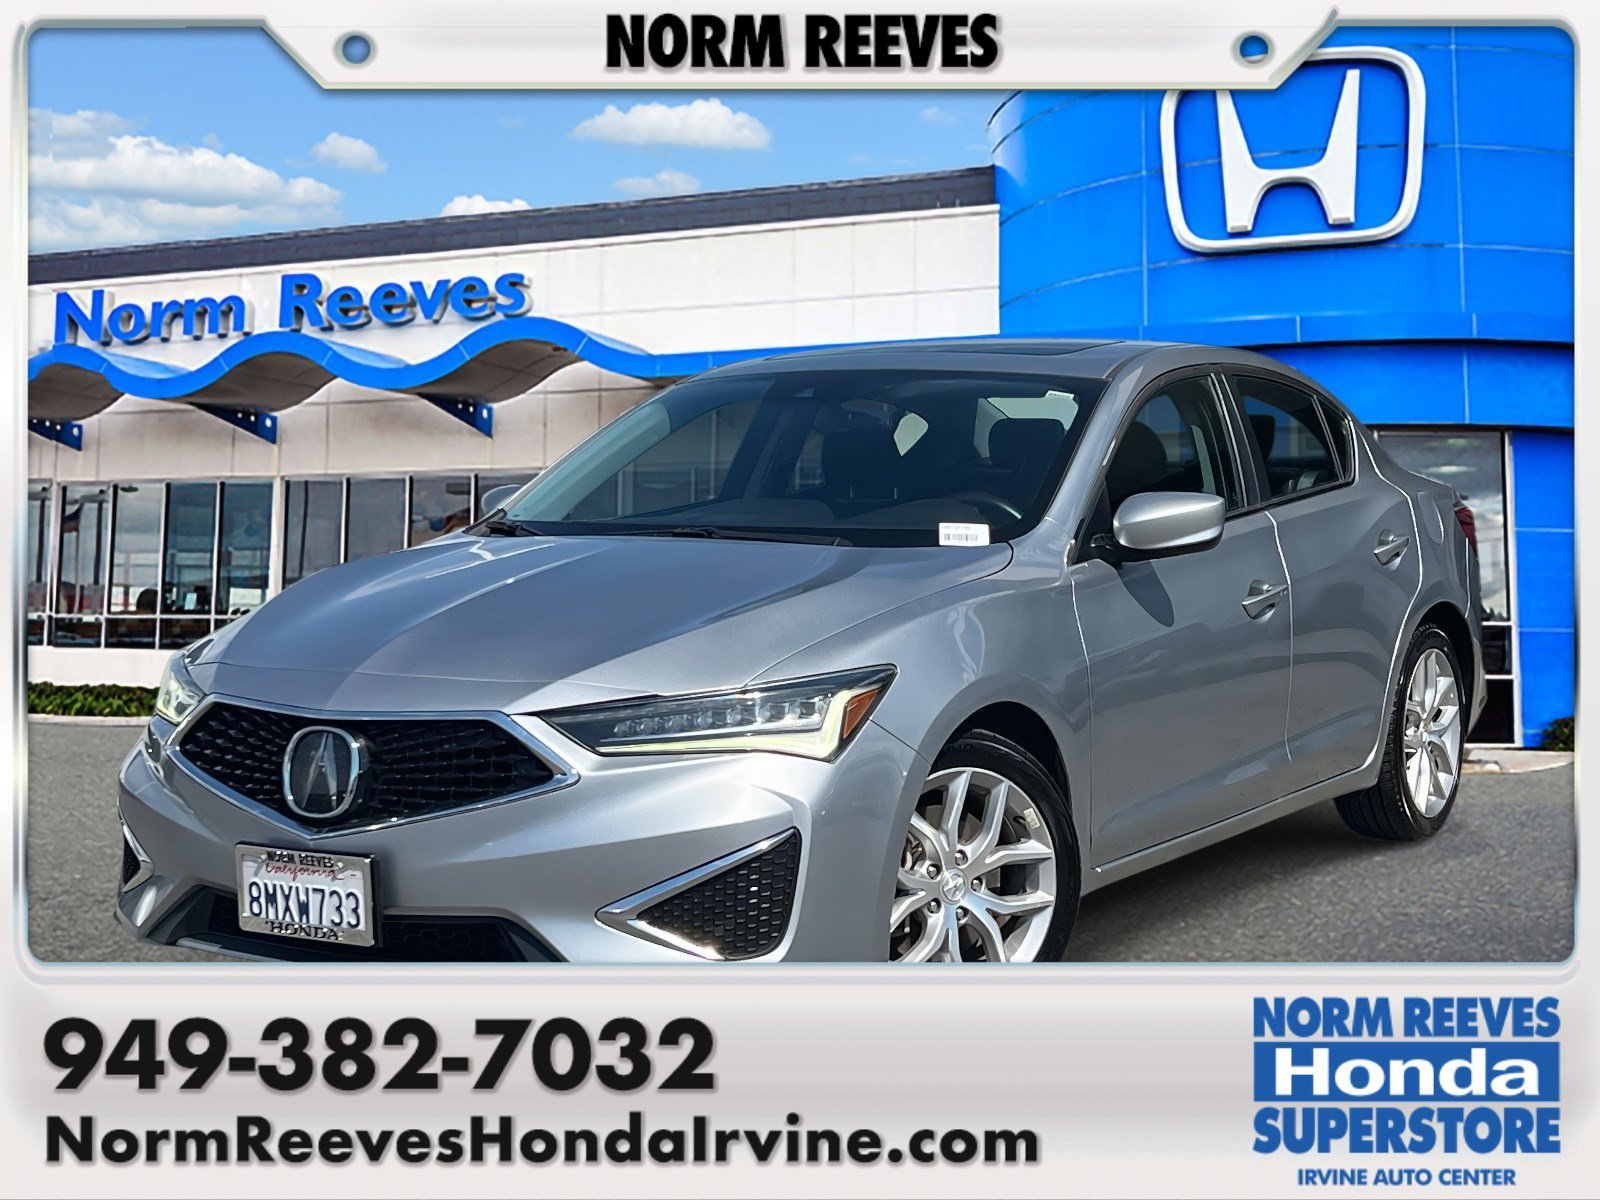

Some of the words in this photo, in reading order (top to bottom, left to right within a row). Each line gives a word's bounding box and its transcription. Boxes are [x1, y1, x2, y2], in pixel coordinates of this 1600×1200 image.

[54, 289, 250, 346] Norm
[278, 272, 530, 332] Reeves
[265, 862, 344, 881] California
[249, 881, 361, 929] 8MXW733
[265, 920, 339, 941] HONDA
